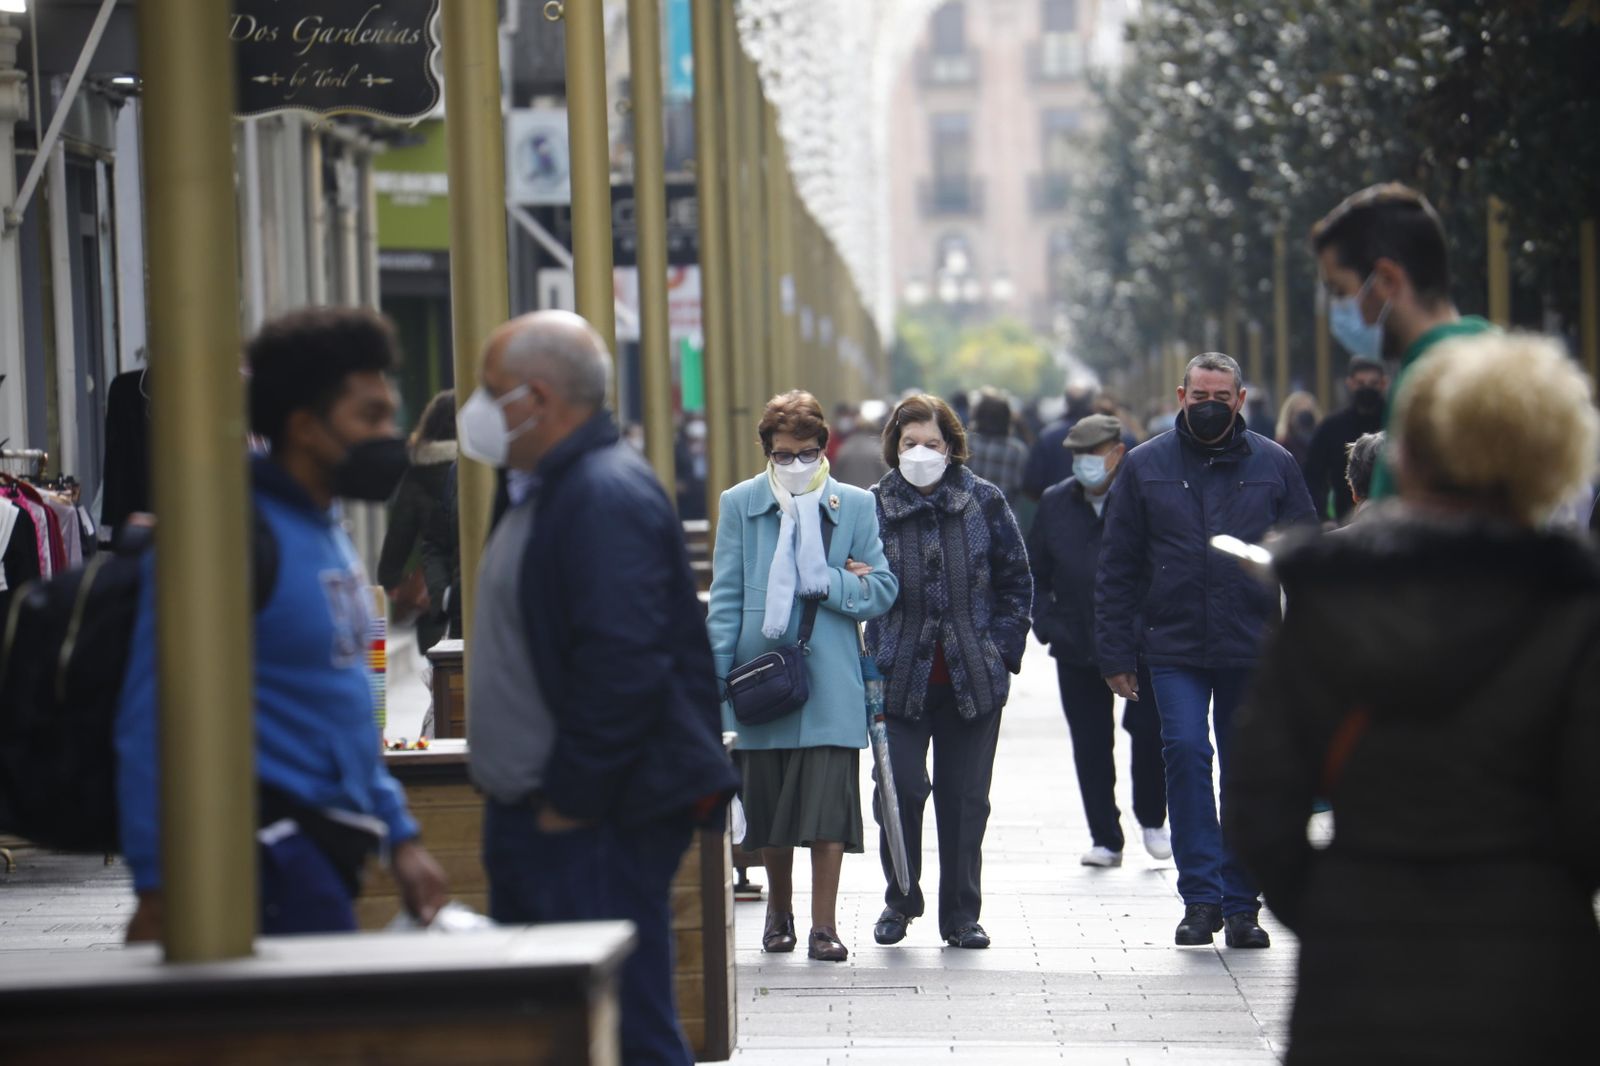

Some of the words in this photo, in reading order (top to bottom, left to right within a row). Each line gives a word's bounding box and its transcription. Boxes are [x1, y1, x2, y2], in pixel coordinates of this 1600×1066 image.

[228, 14, 280, 41] Dos
[292, 4, 420, 56] Gardenias
[283, 62, 308, 101] by
